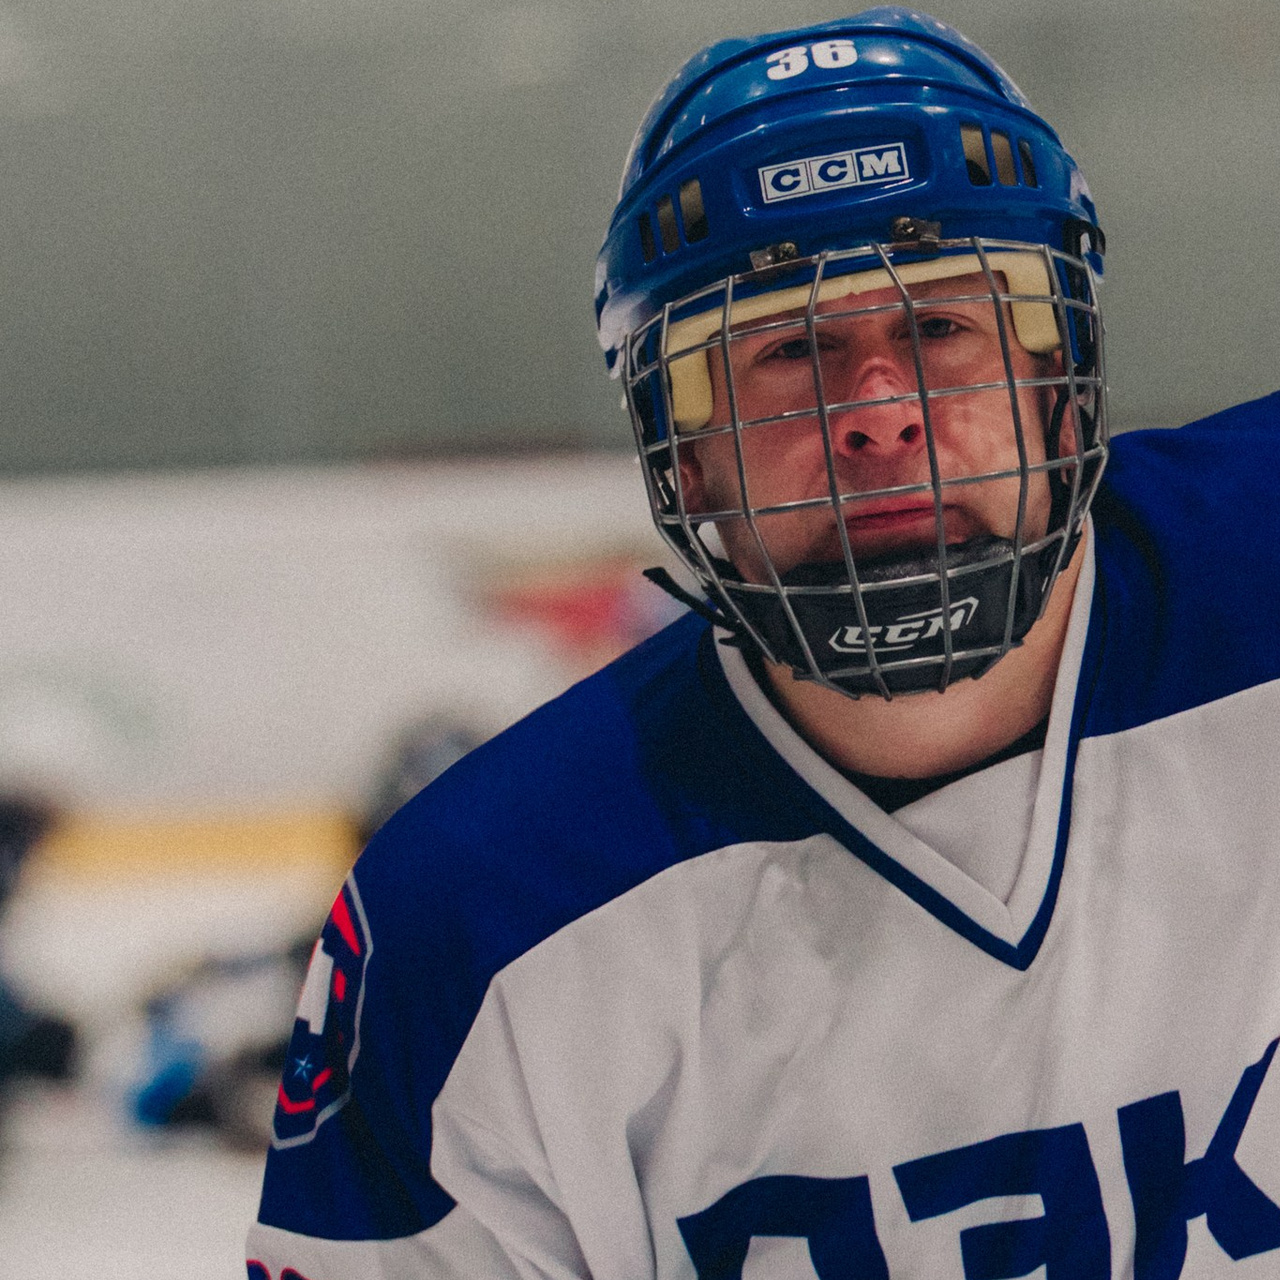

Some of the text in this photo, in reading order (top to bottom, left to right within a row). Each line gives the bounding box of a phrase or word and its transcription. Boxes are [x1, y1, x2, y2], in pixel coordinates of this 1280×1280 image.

[766, 39, 859, 81] 36
[767, 145, 905, 195] CCM
[842, 607, 967, 646] CCM
